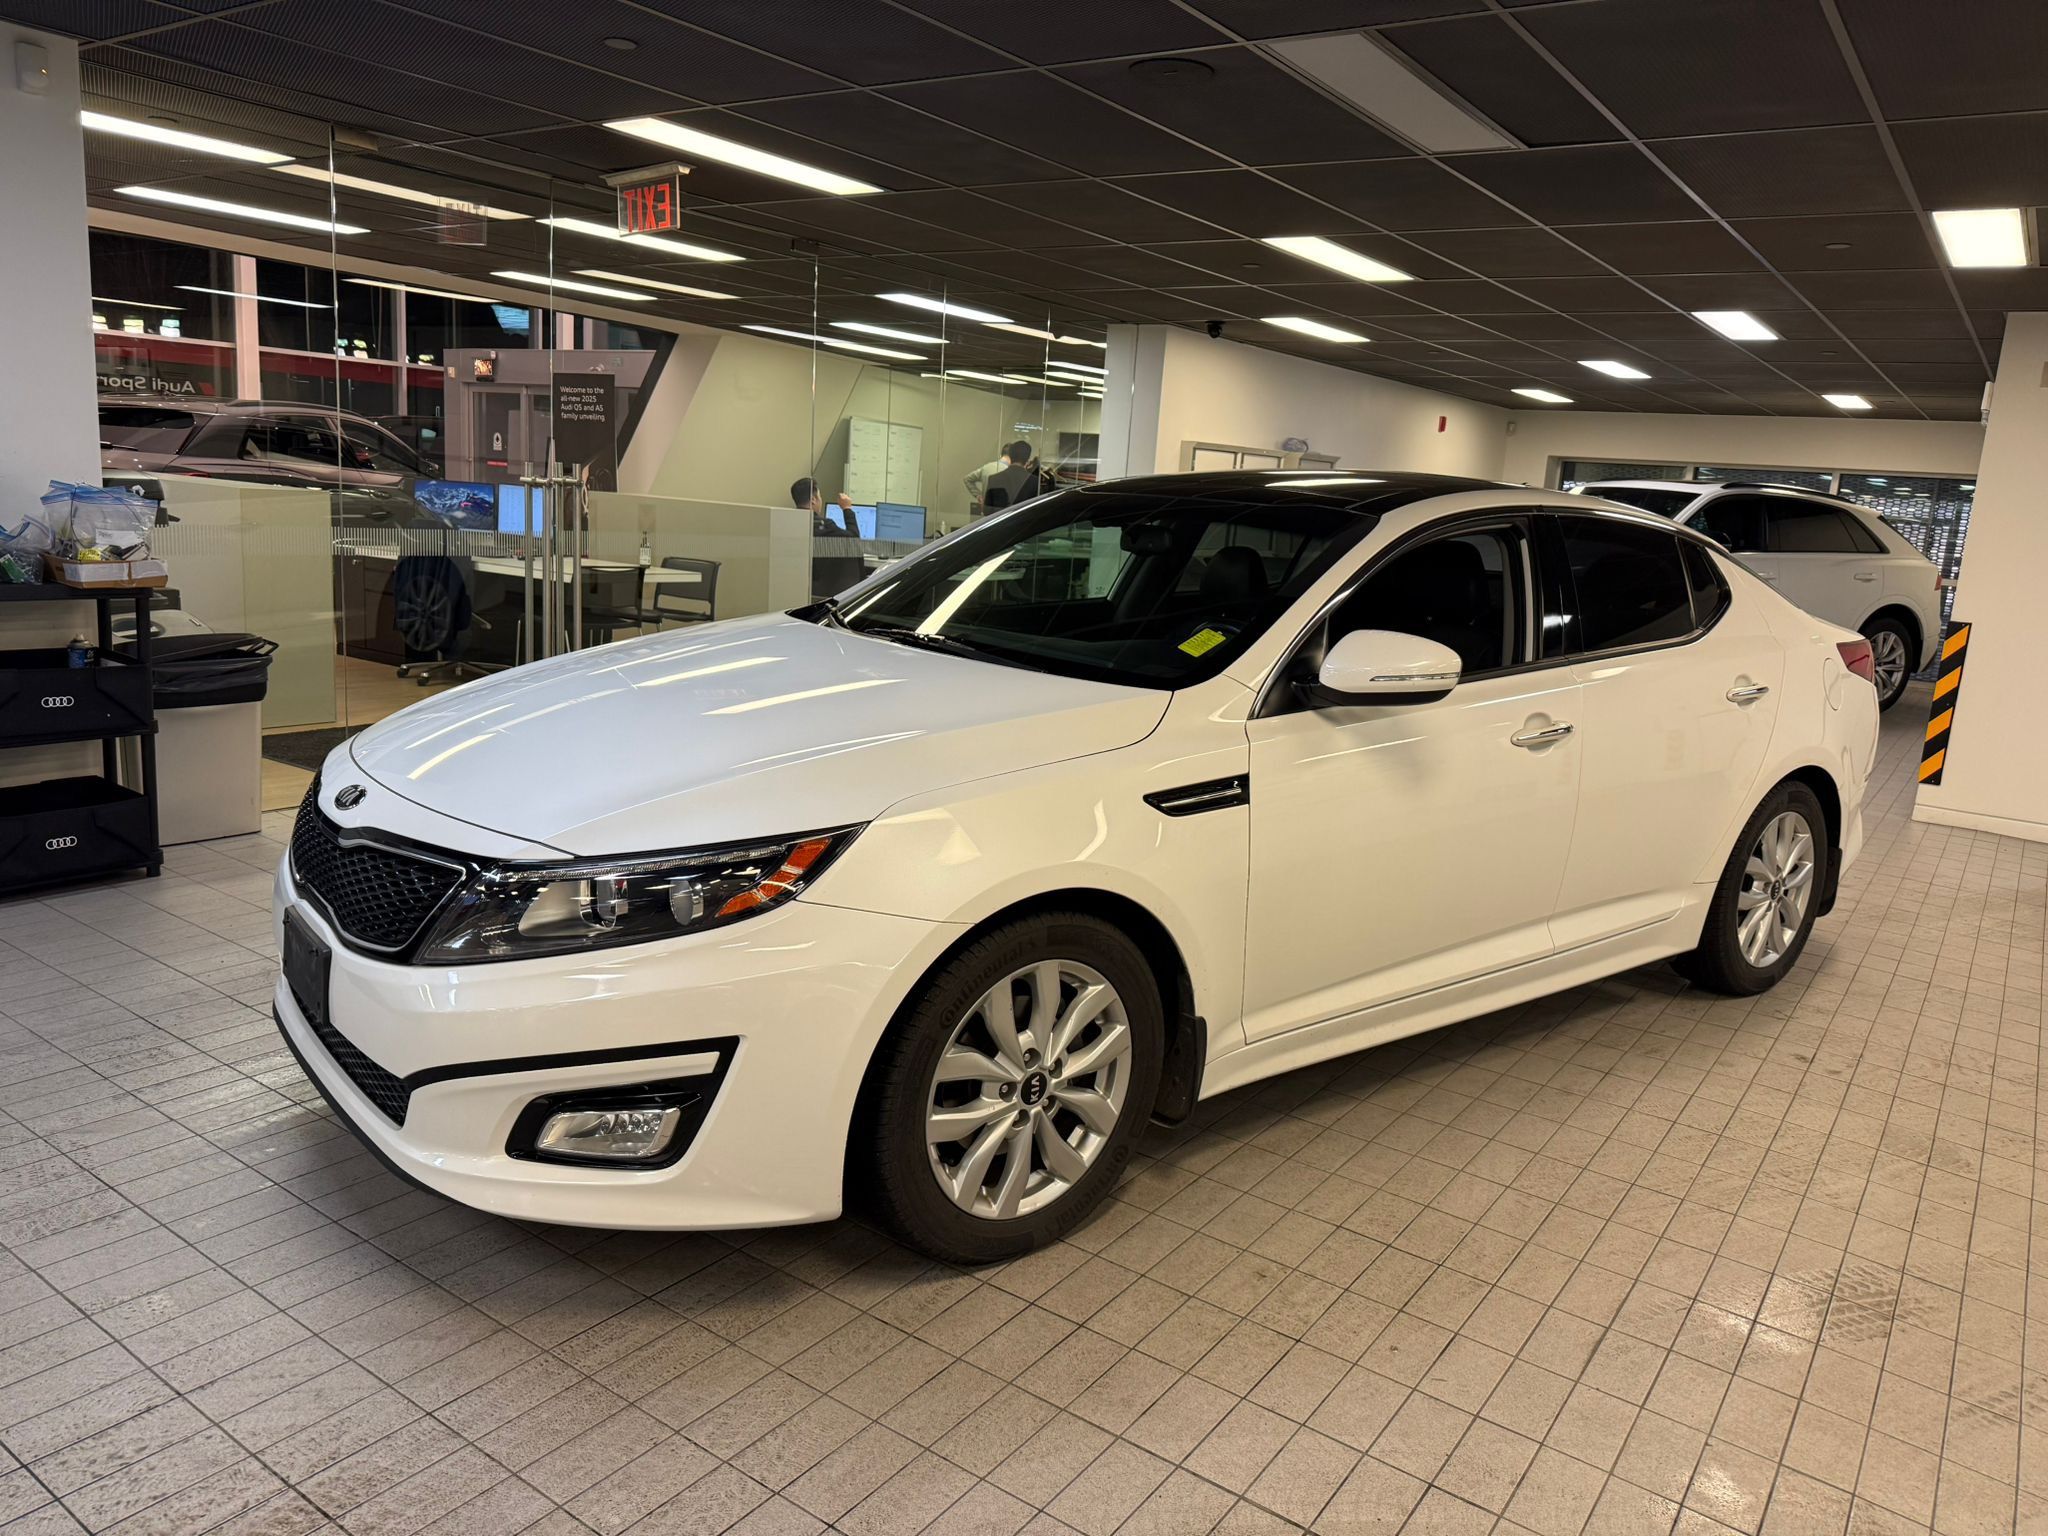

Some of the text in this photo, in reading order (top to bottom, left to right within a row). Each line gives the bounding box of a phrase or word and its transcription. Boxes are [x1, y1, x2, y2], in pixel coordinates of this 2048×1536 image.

[560, 385, 586, 394] Welcome
[561, 412, 578, 421] family
[1029, 1074, 1040, 1103] KIA
